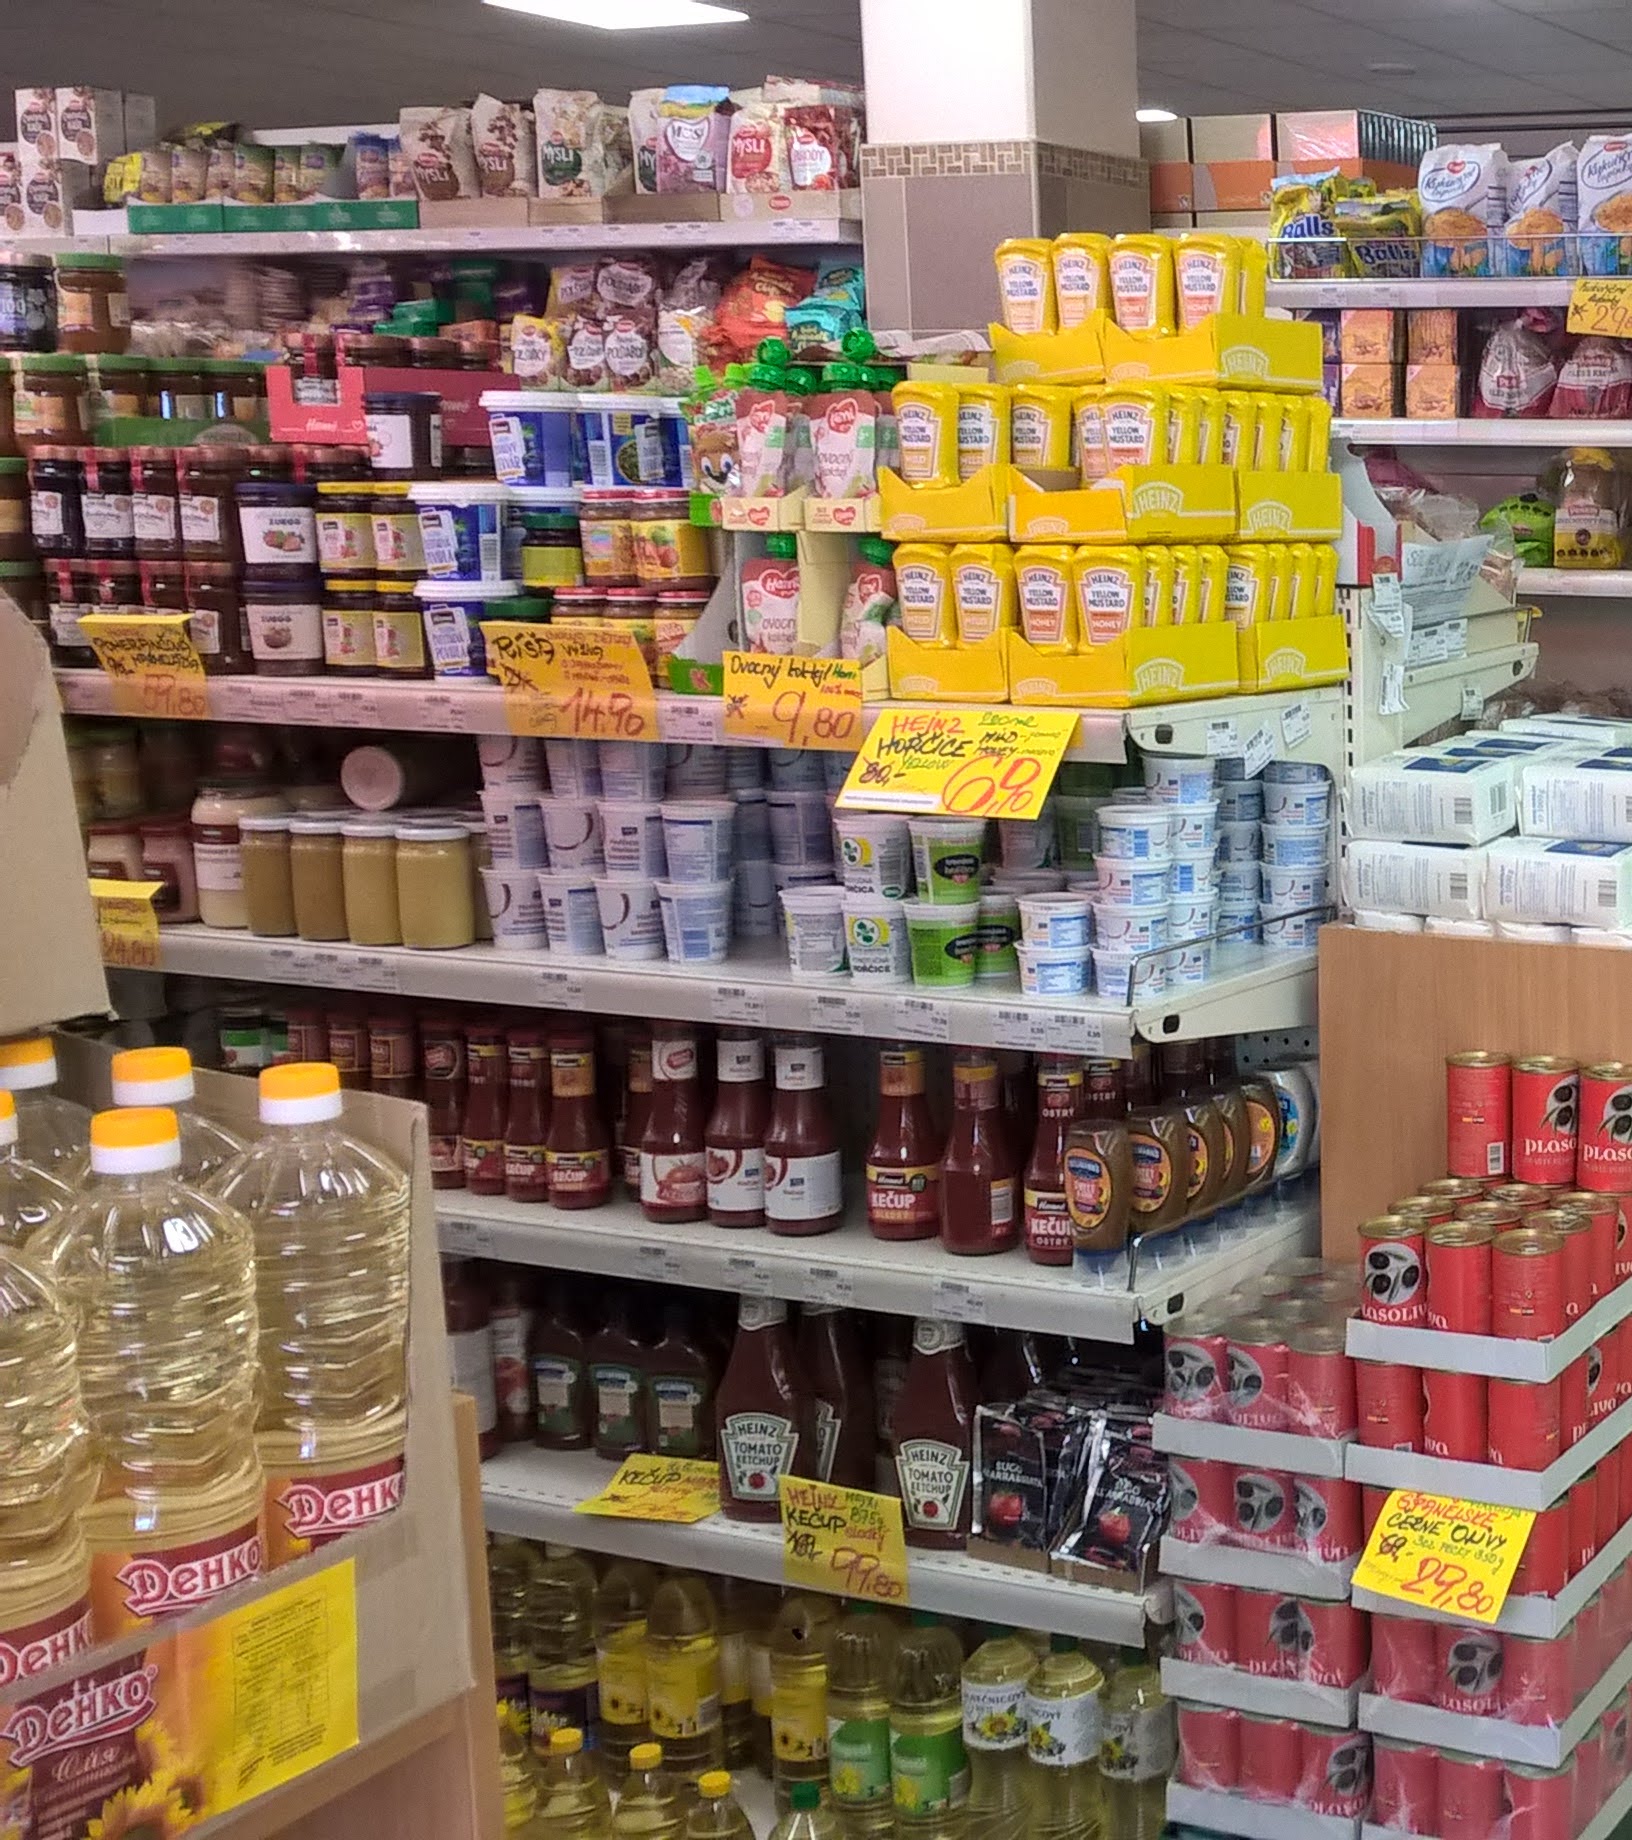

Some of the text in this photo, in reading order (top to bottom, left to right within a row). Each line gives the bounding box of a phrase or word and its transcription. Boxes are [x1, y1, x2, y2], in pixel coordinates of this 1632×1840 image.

[1091, 574, 1120, 586] HEINZ
[871, 1190, 916, 1209] KEČUP
[737, 1422, 778, 1438] HEINZ
[734, 1441, 783, 1457] TOMATO
[735, 1455, 780, 1468] KETCHUP
[910, 1449, 947, 1466] HEINZ
[618, 1467, 682, 1486] KEČUP
[908, 1469, 955, 1485] TOMATO
[910, 1482, 953, 1495] KETCHUP
[1400, 1556, 1494, 1615] 29,80
